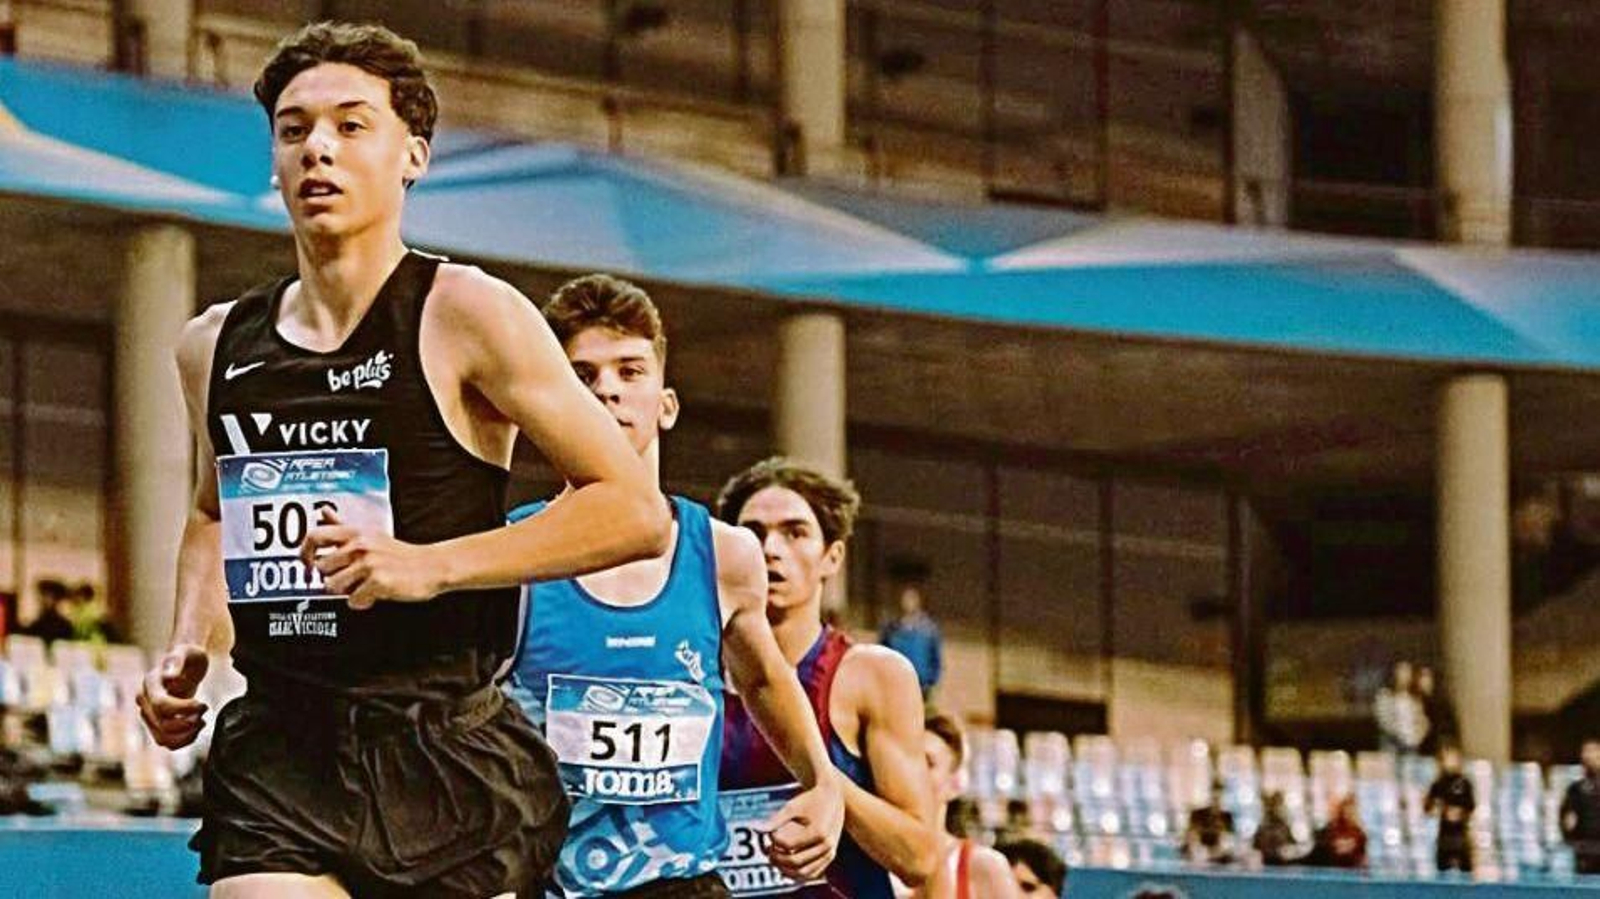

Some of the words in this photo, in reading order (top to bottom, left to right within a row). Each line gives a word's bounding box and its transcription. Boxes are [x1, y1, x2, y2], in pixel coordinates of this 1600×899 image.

[279, 418, 371, 446] VICKY
[245, 560, 325, 597] Jom
[590, 720, 671, 762] 511
